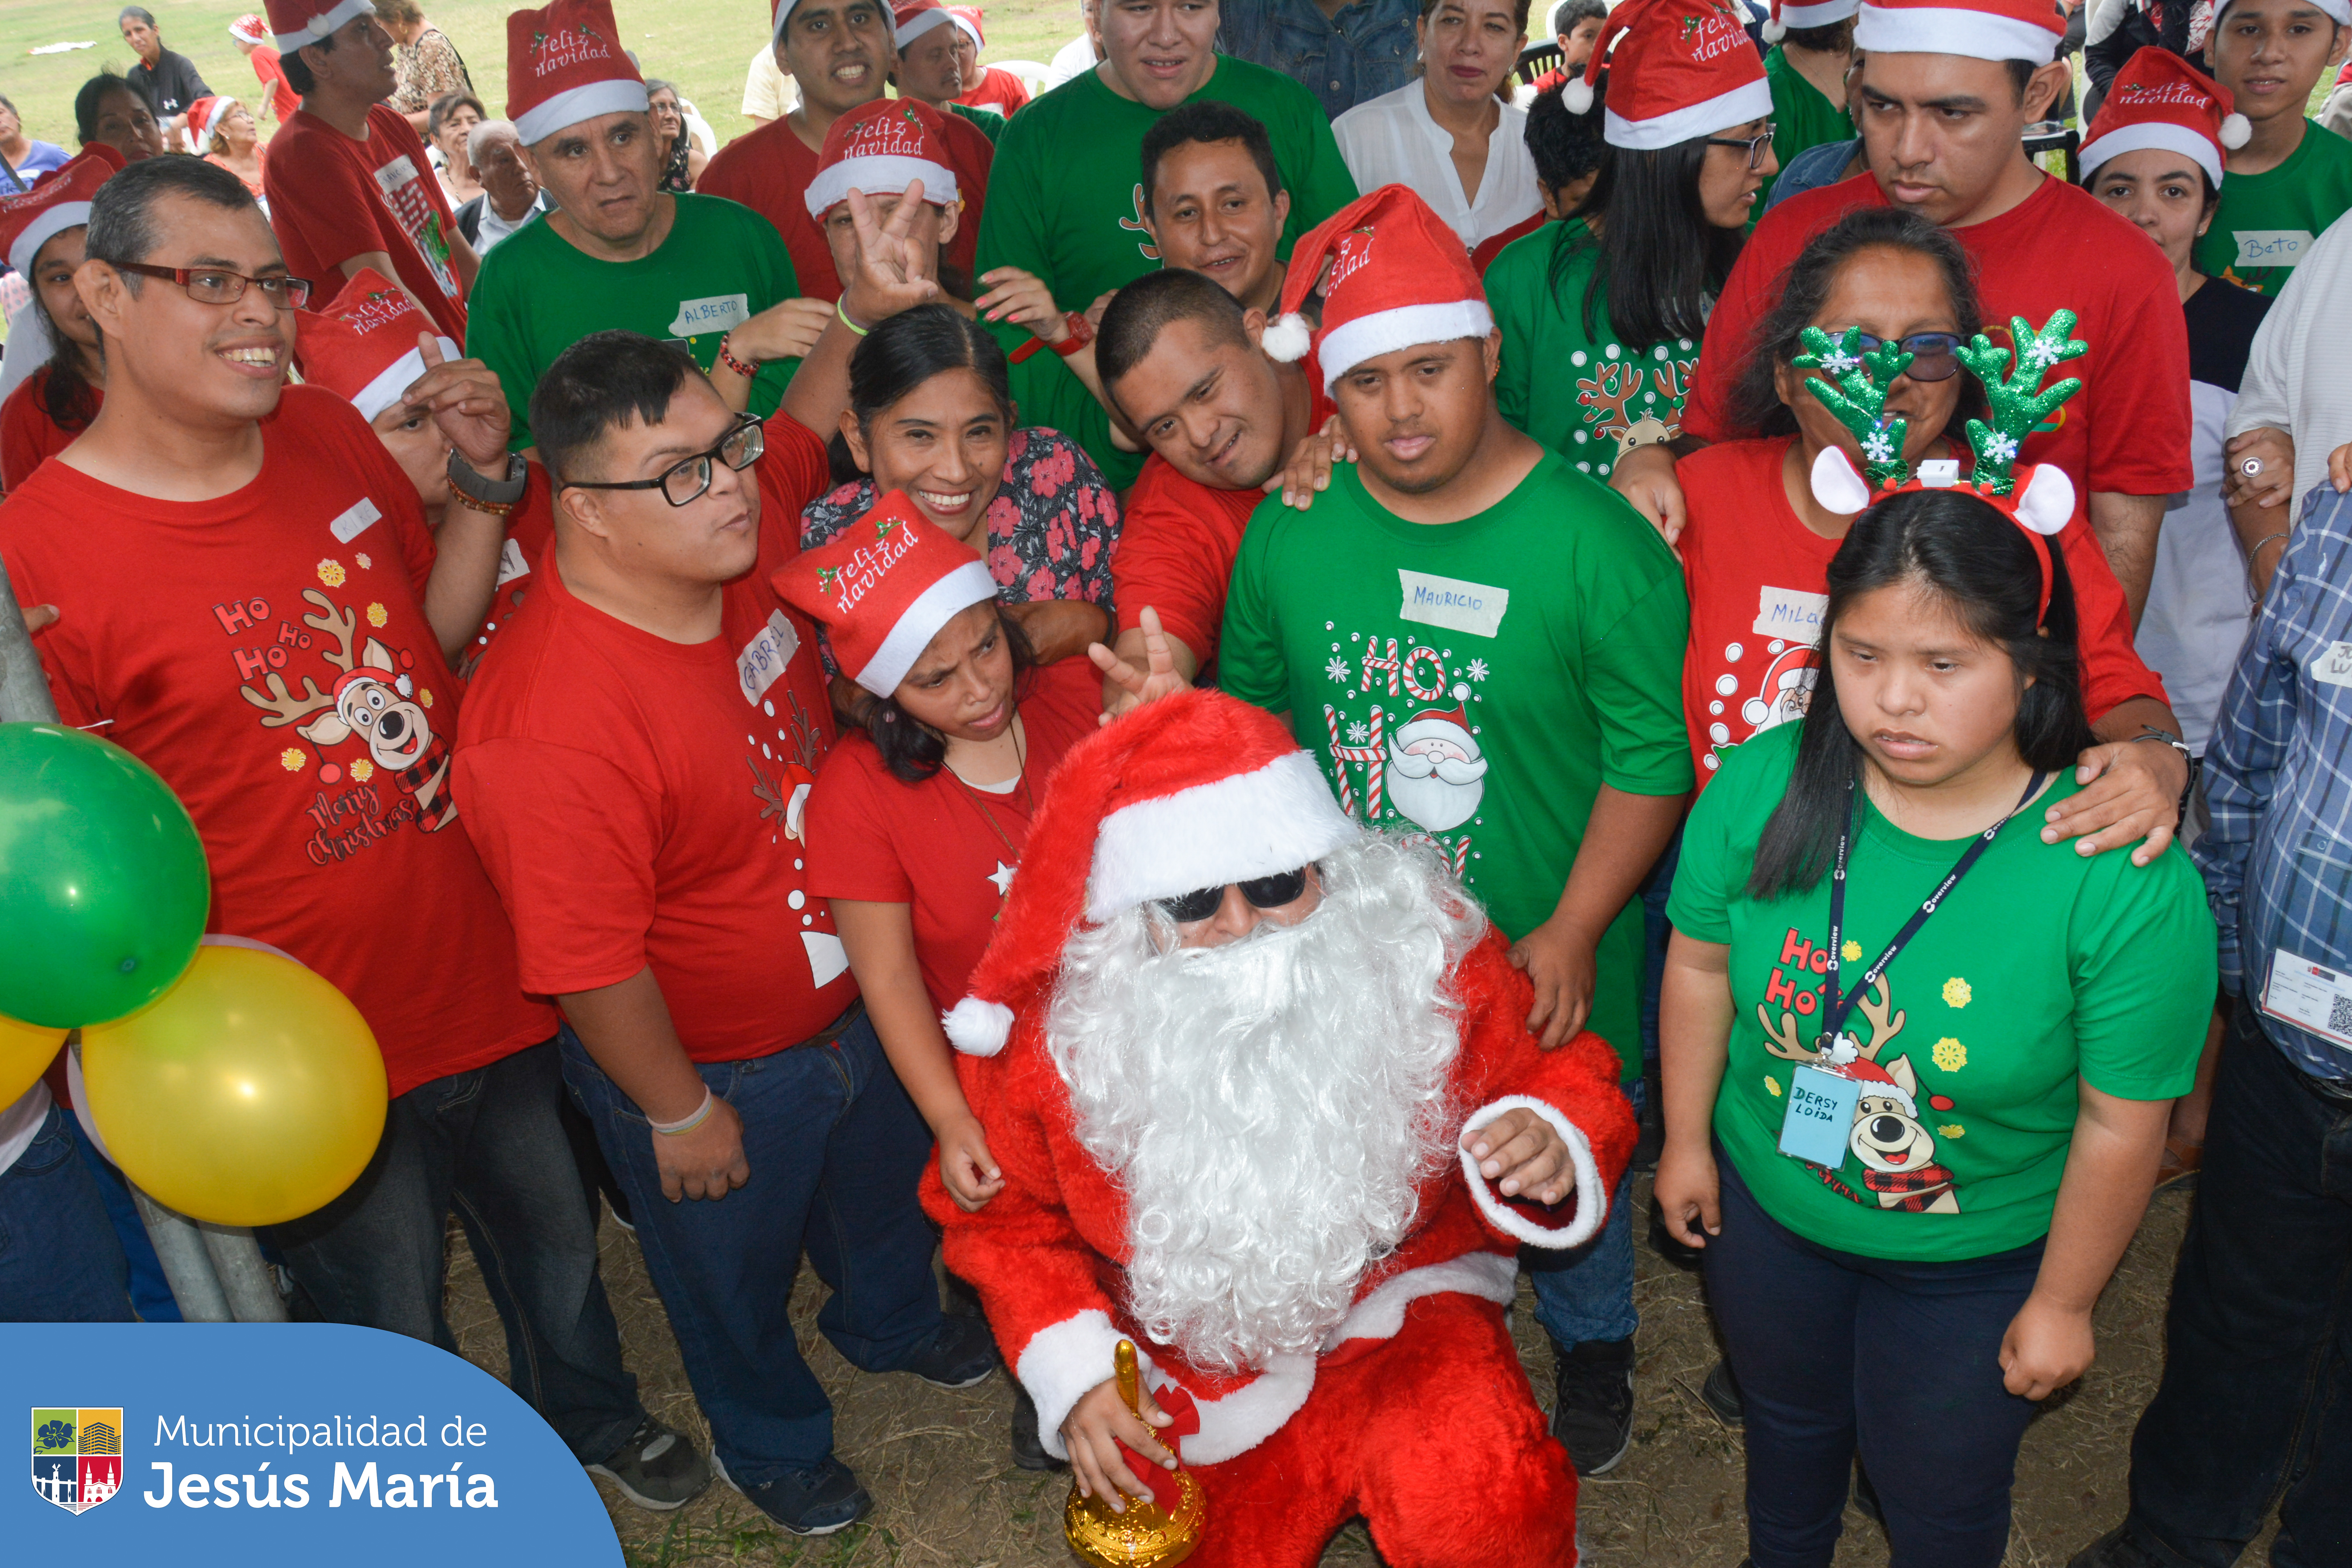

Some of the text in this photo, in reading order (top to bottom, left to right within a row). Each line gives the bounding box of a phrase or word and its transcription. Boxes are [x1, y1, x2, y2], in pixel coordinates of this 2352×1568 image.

[535, 44, 611, 77] navidad
[540, 30, 588, 66] feliz
[2119, 90, 2209, 109] navidad
[849, 116, 906, 149] feliz
[843, 136, 924, 160] navidad
[2244, 238, 2298, 258] Beto
[685, 301, 737, 324] ALBERTO
[338, 505, 372, 534] KIKE
[835, 538, 889, 600] feliz
[837, 520, 919, 614] navidad
[1414, 585, 1482, 610] MAURICIO
[305, 784, 381, 830] Merry
[307, 799, 417, 865] Christmas
[1931, 874, 1956, 903] overview
[1830, 925, 1838, 960] overview
[1873, 945, 1897, 974] overview
[1793, 1087, 1838, 1111] DERSY
